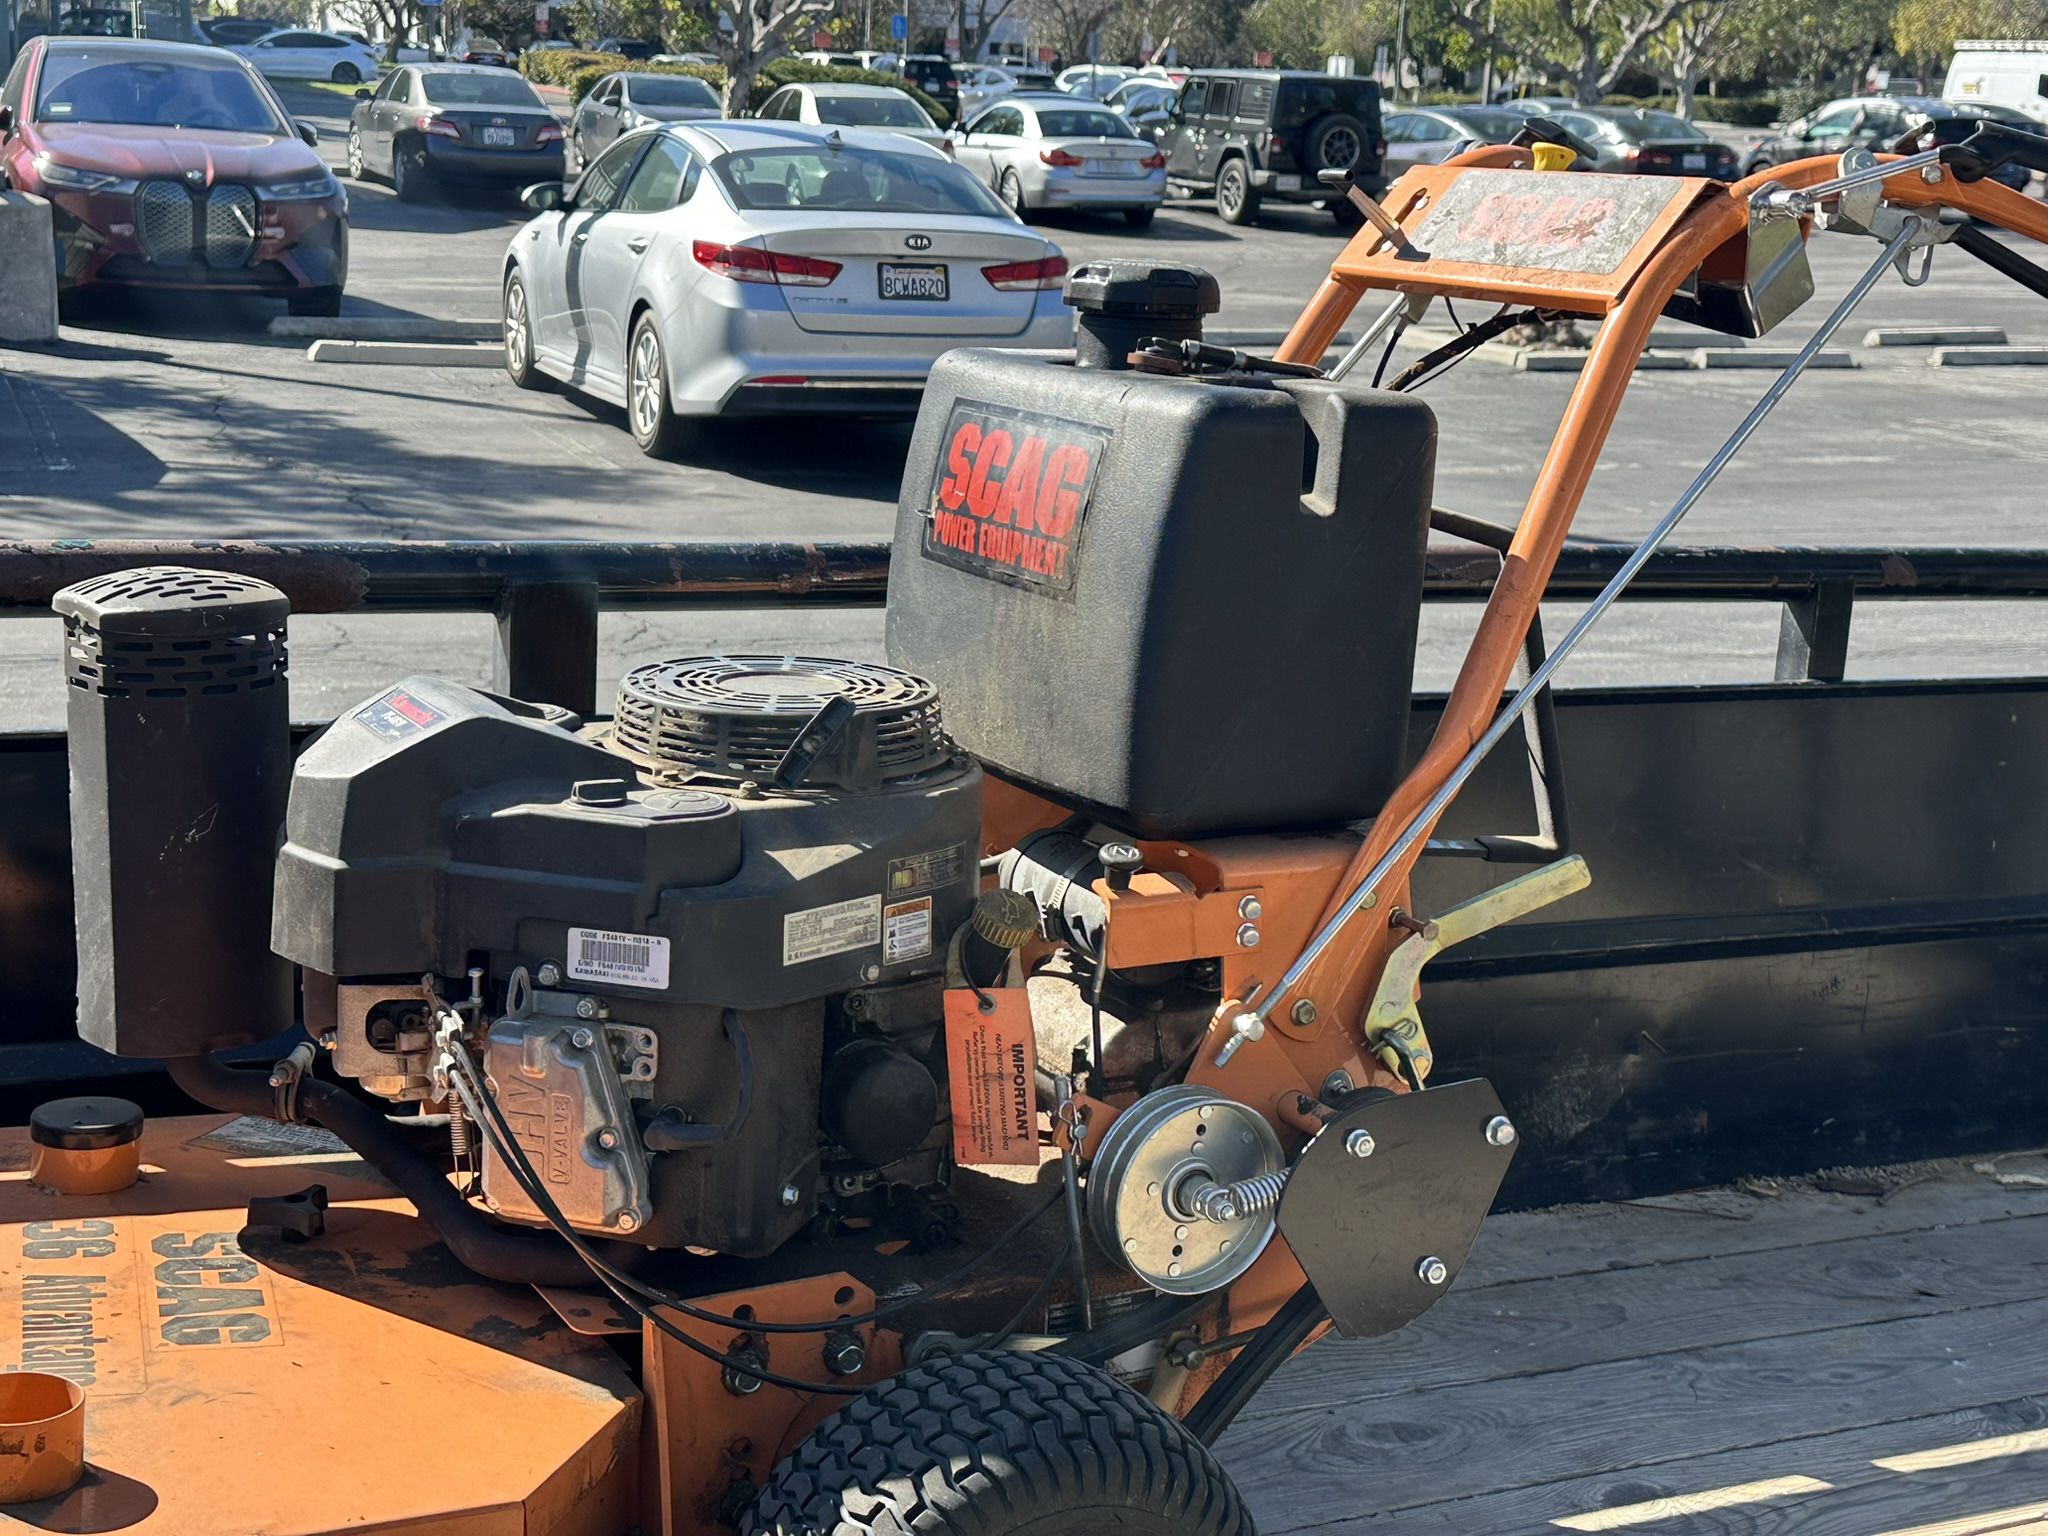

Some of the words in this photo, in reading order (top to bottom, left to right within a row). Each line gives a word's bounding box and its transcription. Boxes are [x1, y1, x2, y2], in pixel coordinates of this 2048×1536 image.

[908, 237, 929, 248] KIA
[939, 422, 1090, 539] SCAG
[933, 508, 977, 554] POWER
[978, 522, 1070, 580] EQUIPMENT
[1011, 1043, 1030, 1141] IMPORTANT
[552, 1099, 569, 1180] V-VALVE
[22, 1220, 116, 1259] 36
[151, 1232, 271, 1345] SCAG
